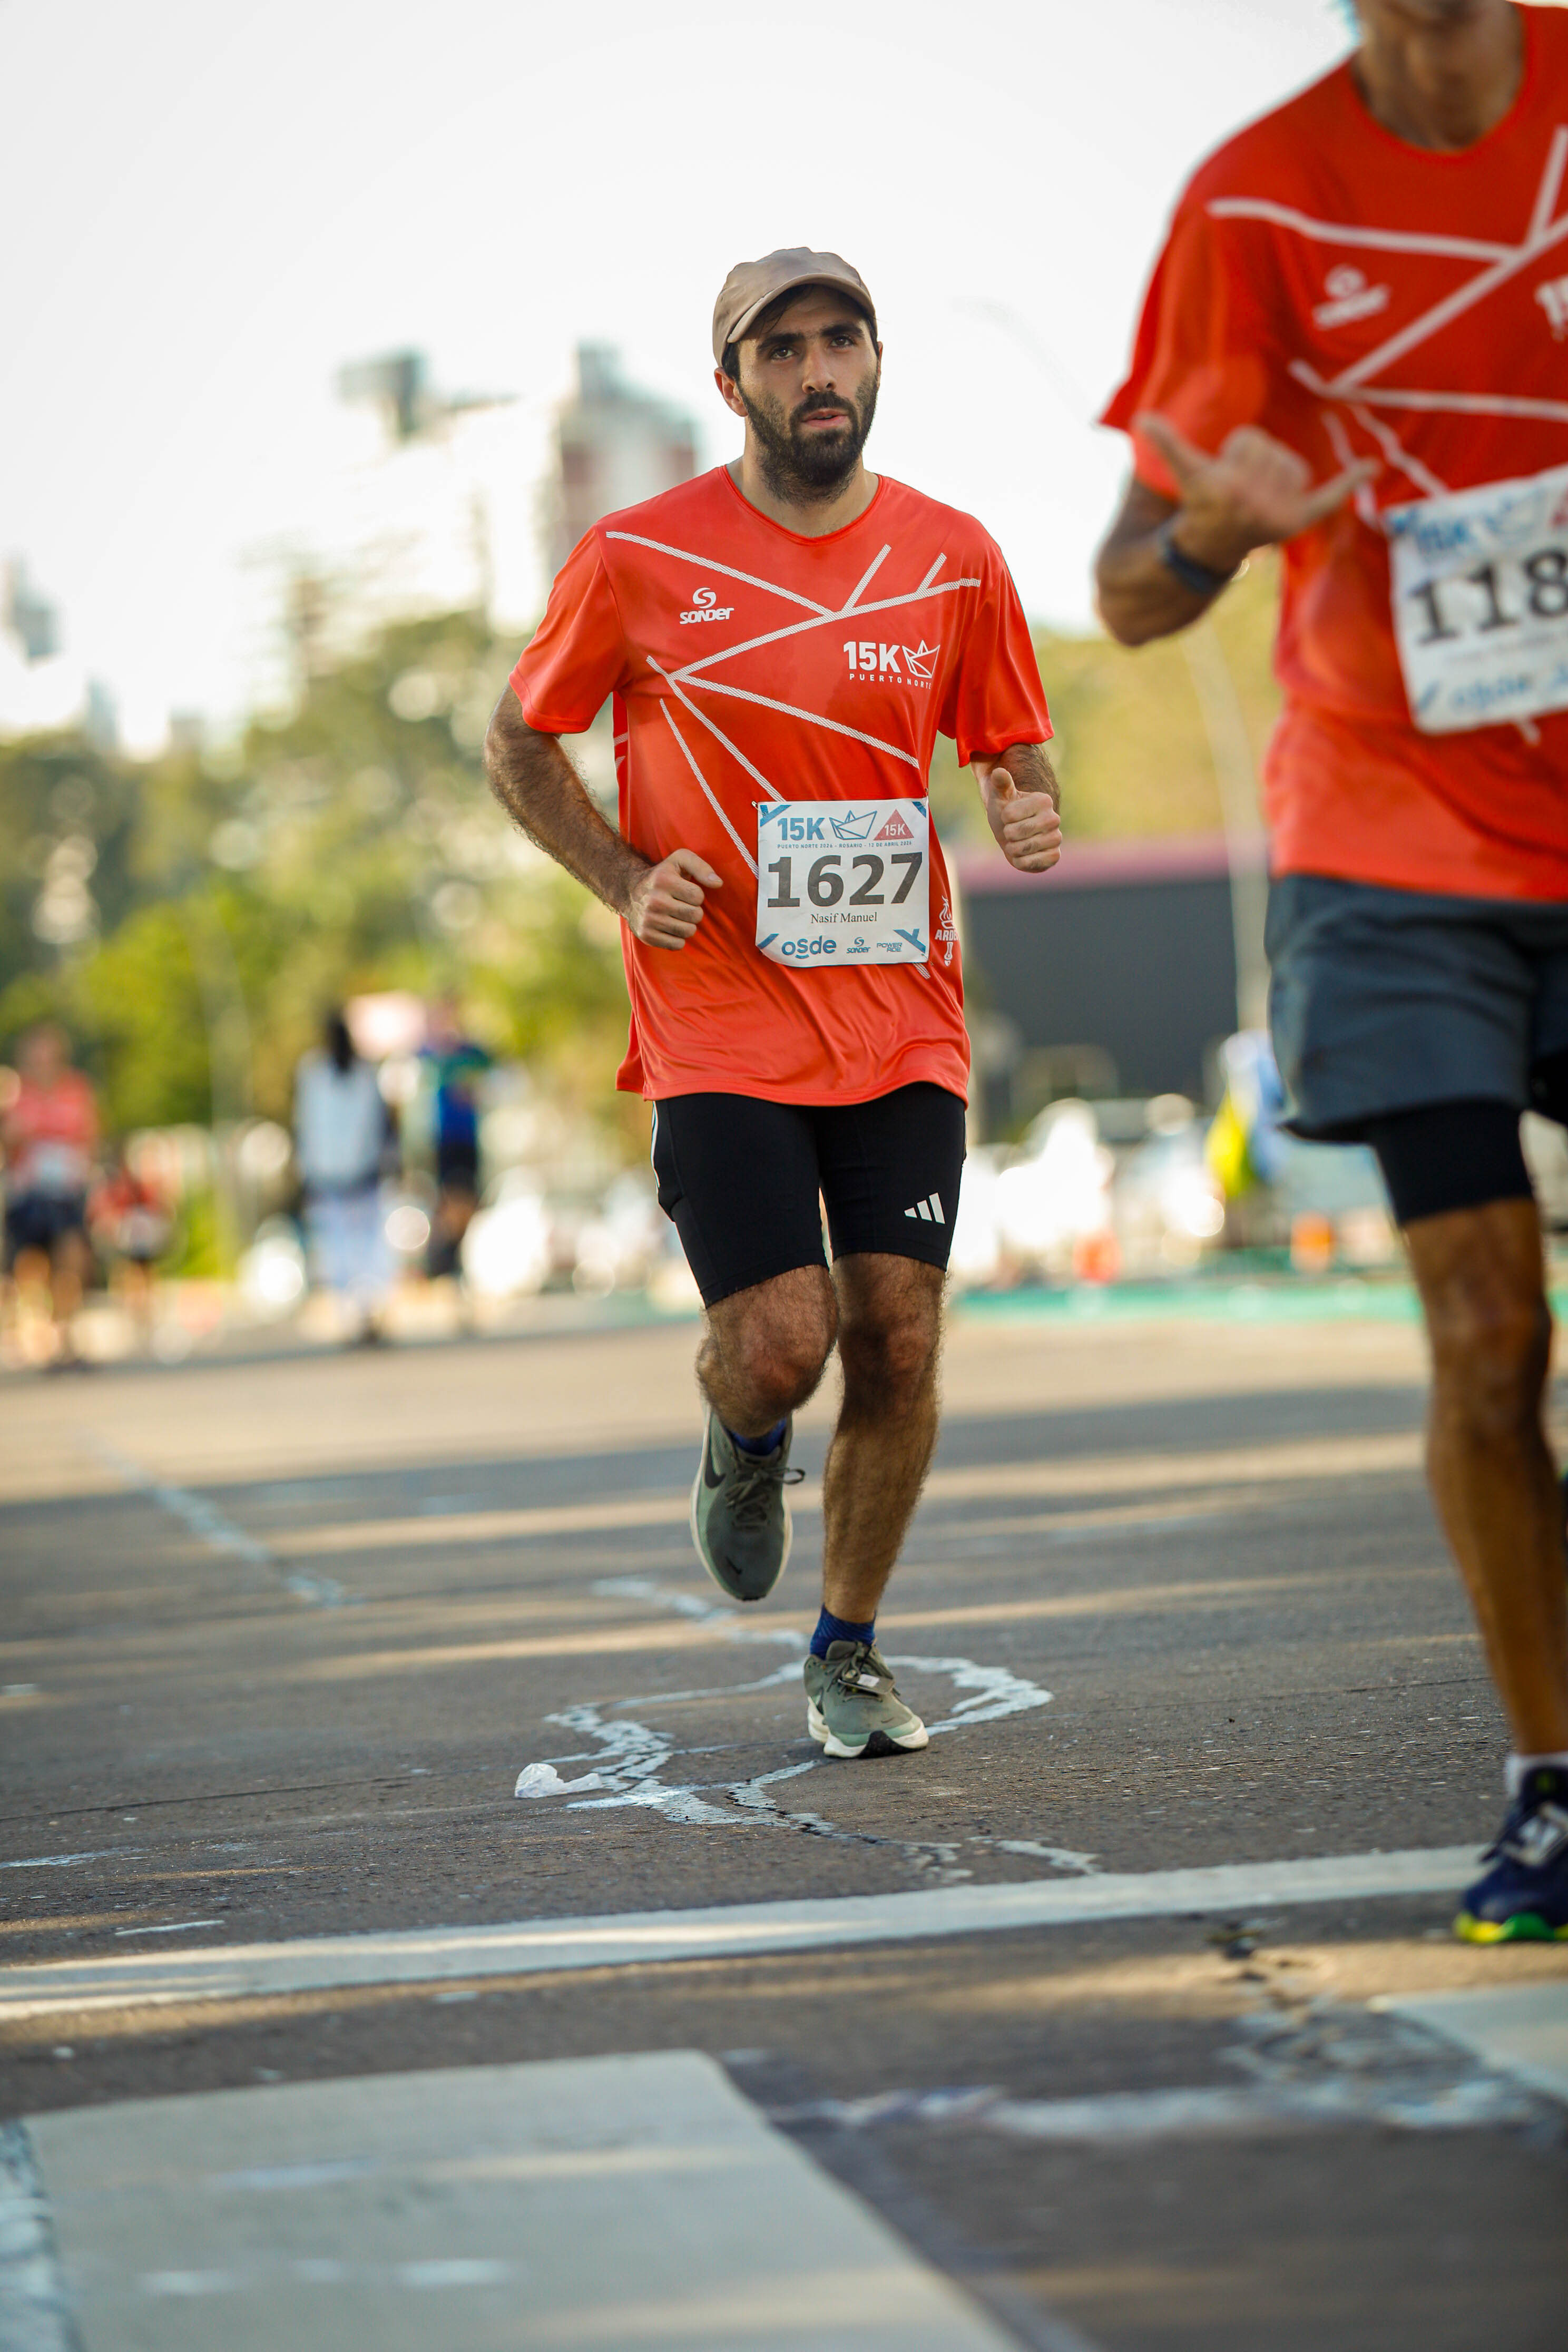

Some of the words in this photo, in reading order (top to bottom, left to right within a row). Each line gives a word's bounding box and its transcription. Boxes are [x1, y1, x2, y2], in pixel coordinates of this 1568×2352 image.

[843, 641, 901, 673] 15K
[849, 673, 902, 683] PUERTO
[907, 678, 932, 690] NORTE
[777, 817, 825, 840] 15K
[884, 823, 906, 836] 15K
[768, 851, 923, 907] 1627
[811, 913, 839, 924] Nasif
[840, 912, 877, 923] Manuel
[781, 935, 837, 956] osde
